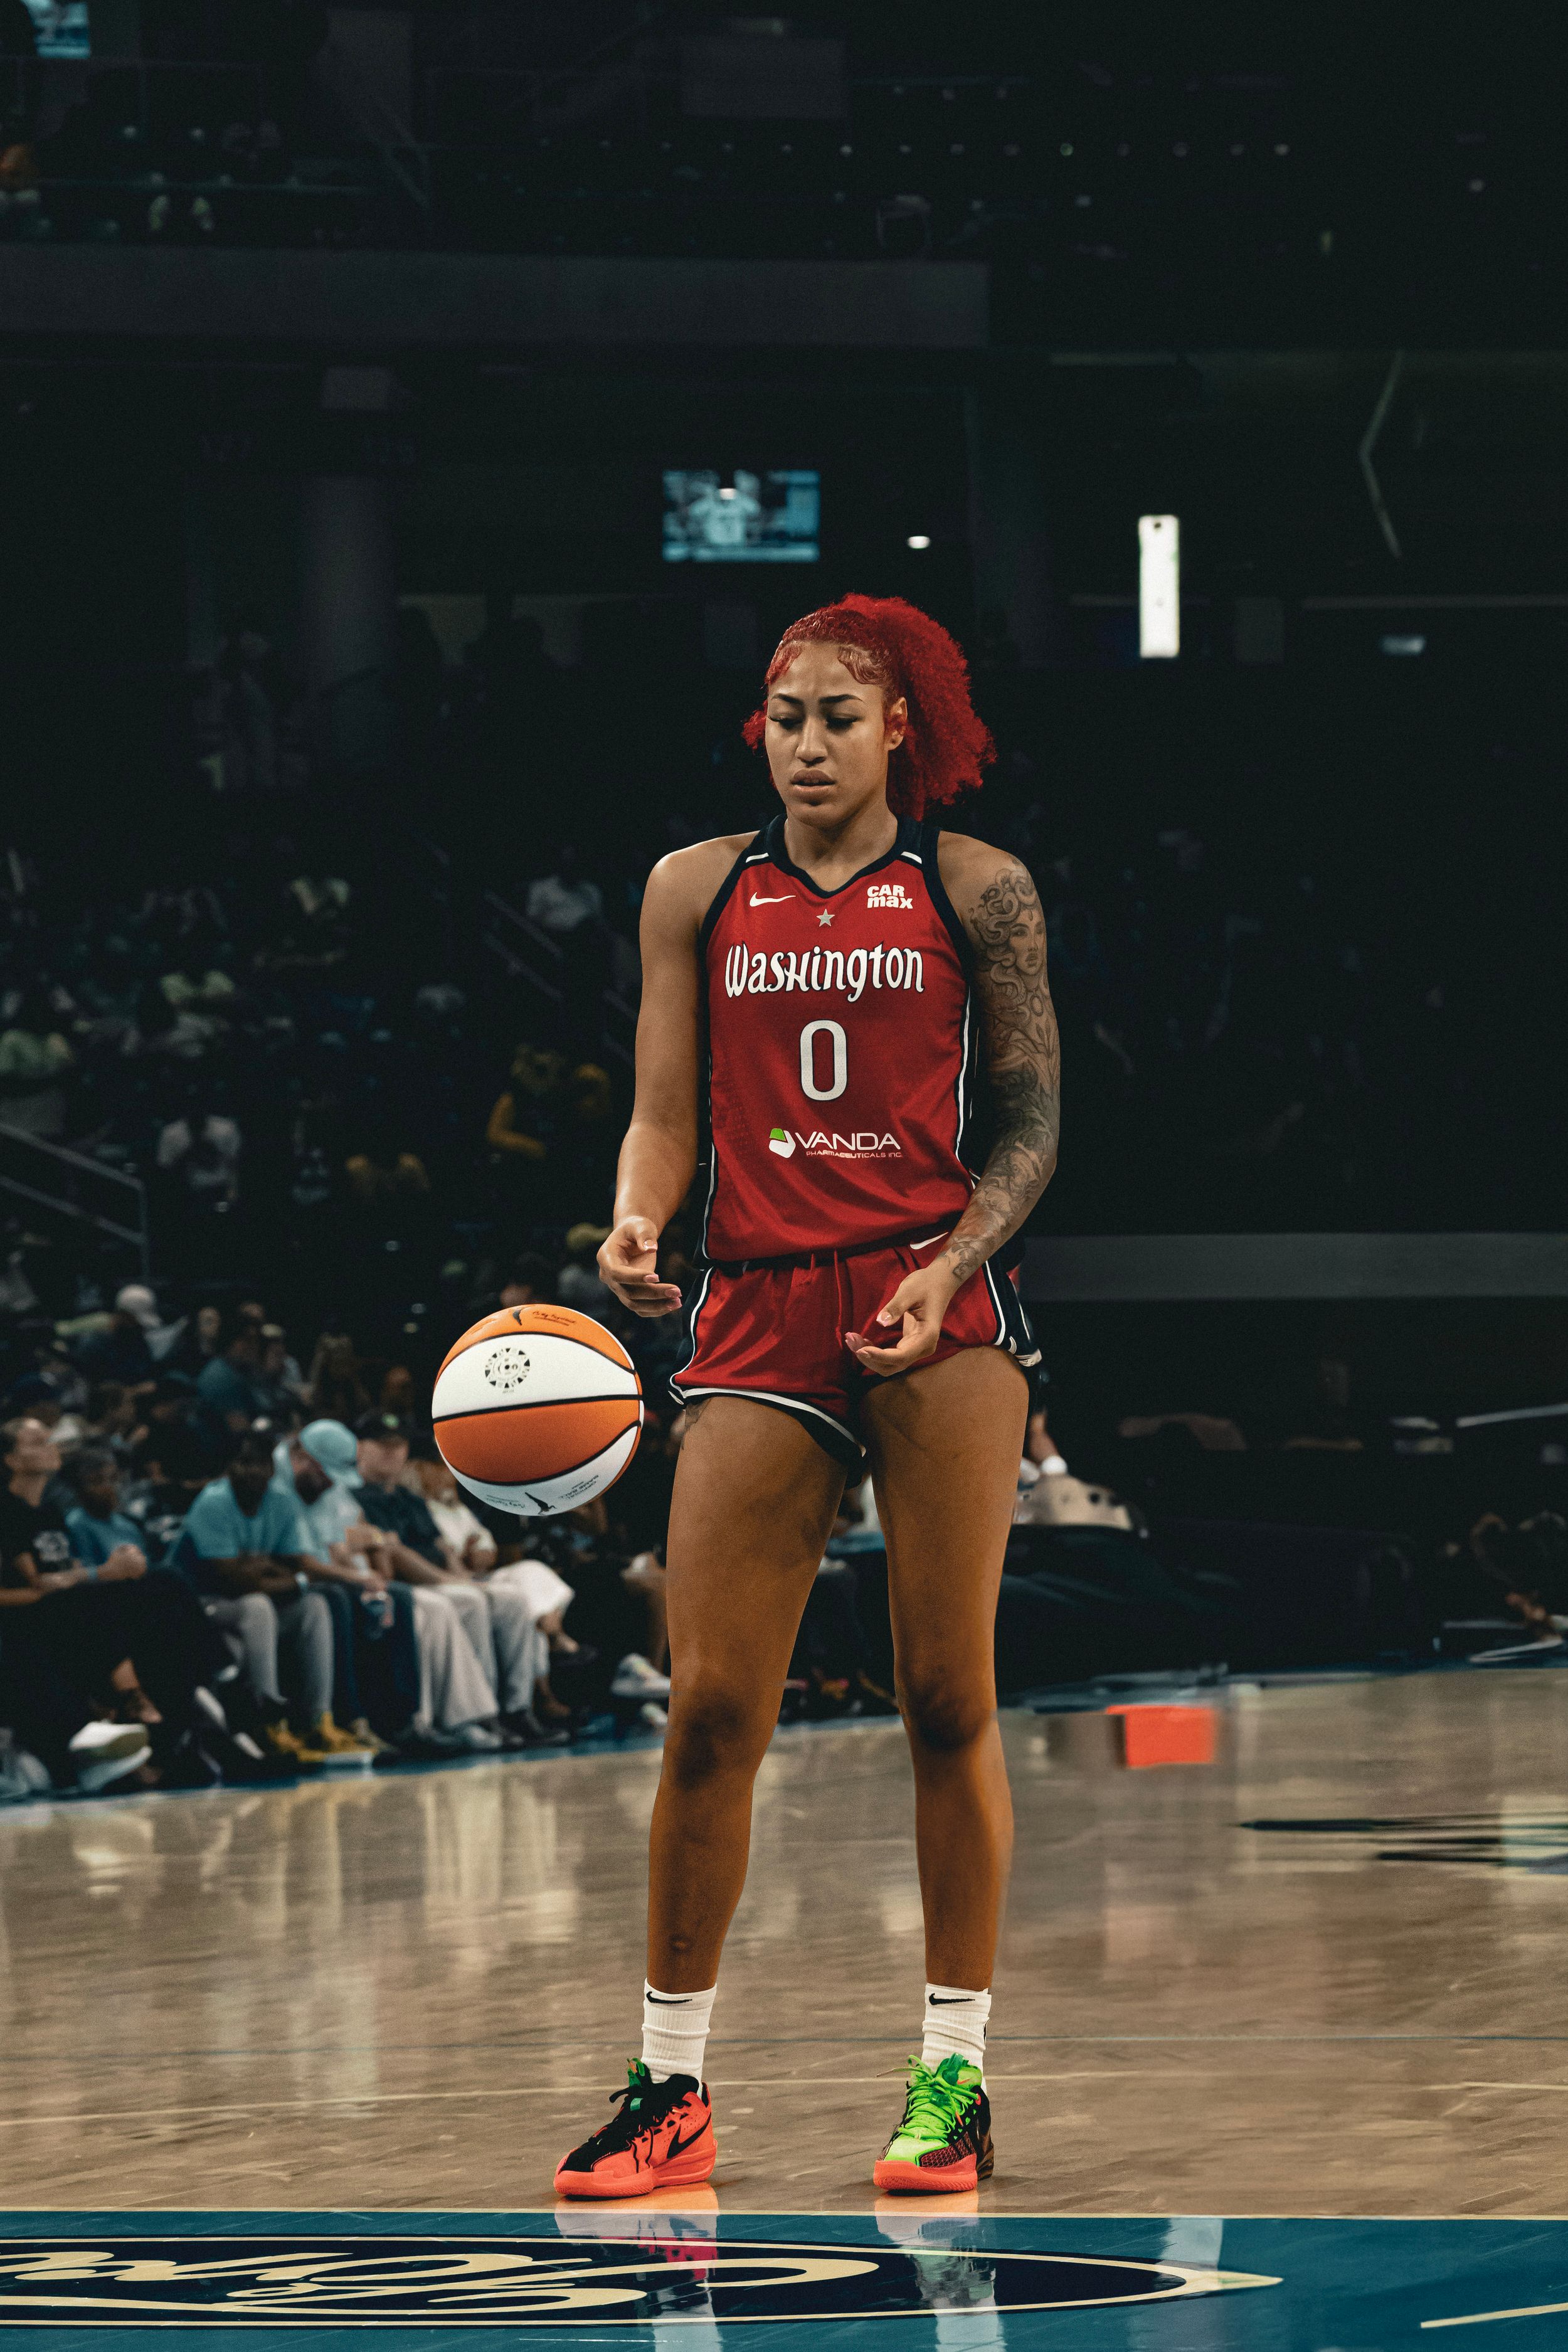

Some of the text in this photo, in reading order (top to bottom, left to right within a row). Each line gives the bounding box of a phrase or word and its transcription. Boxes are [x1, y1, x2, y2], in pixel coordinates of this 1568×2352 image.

[867, 884, 904, 897] CAR
[867, 896, 913, 909] max
[800, 1020, 847, 1101] 0
[795, 1131, 901, 1152] VANDA
[806, 1149, 886, 1159] PHARMACEUTICALS
